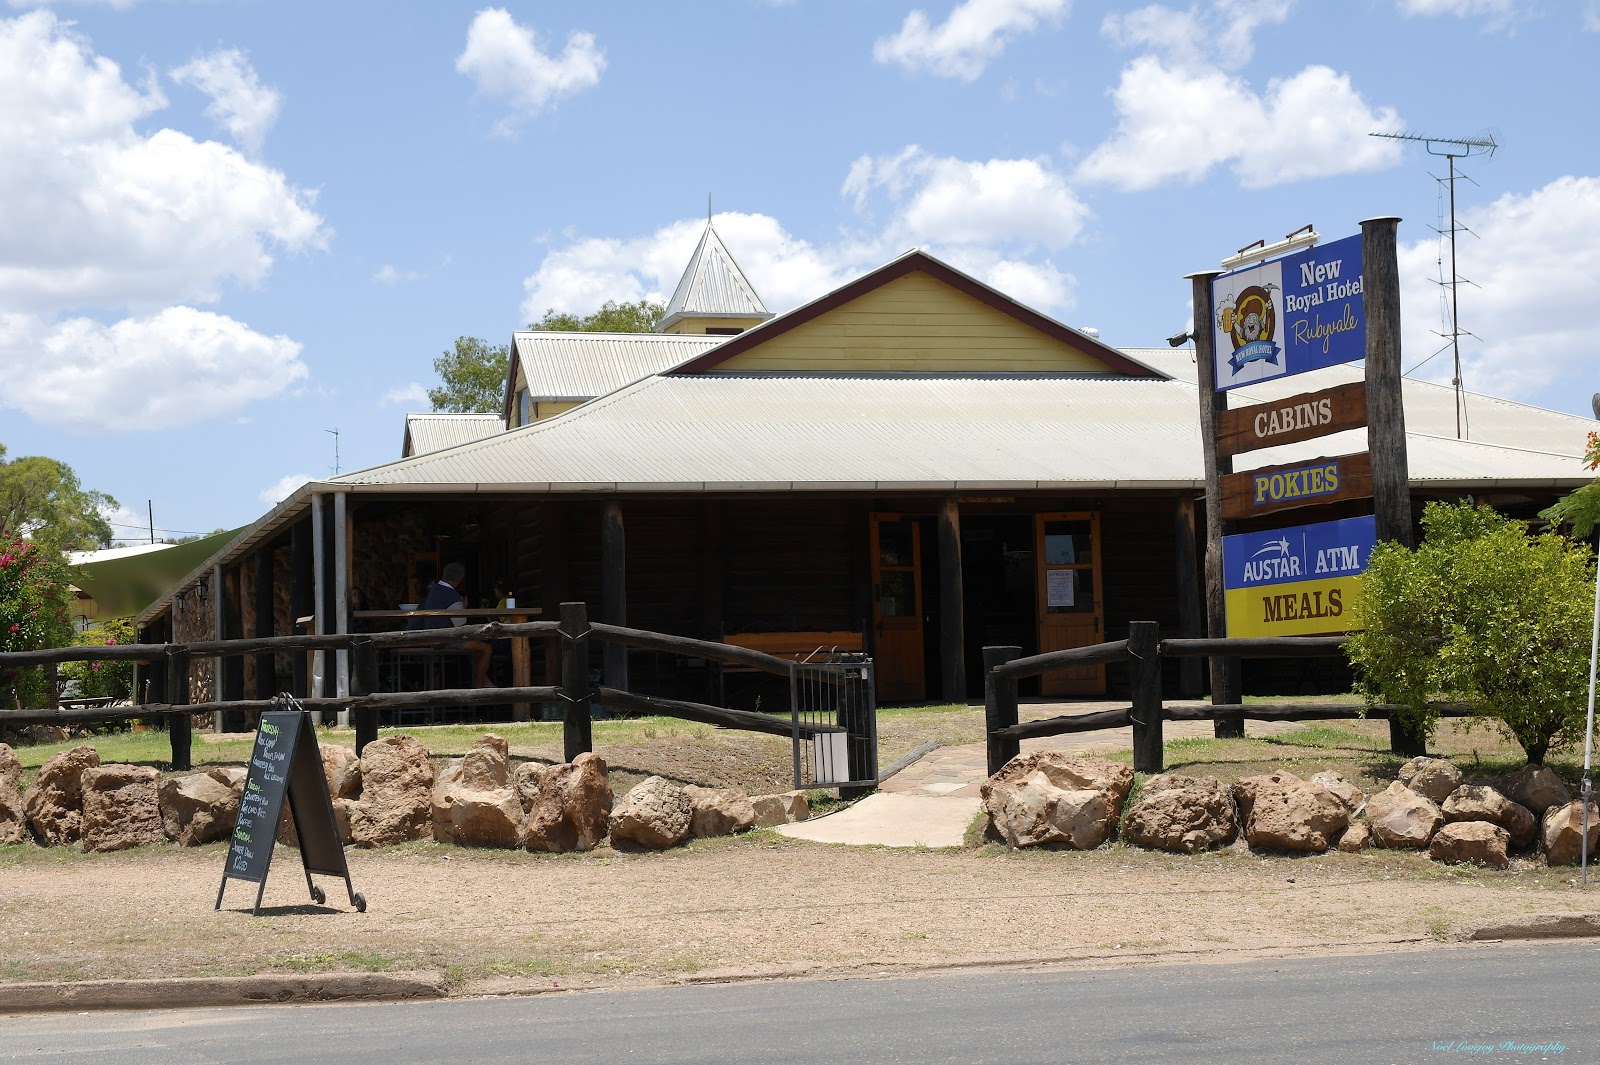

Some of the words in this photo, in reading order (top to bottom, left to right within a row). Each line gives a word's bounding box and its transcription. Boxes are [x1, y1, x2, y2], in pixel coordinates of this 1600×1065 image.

[1300, 259, 1342, 288] New
[1285, 286, 1324, 313] Royal
[1326, 275, 1364, 303] Hotel
[1291, 303, 1358, 354] Rubyvale
[1254, 398, 1333, 438] CABINS
[1255, 465, 1339, 502] POKIES
[1243, 555, 1302, 583] AUSTAR
[1314, 545, 1360, 574] ATM
[1262, 588, 1343, 623] MEALS
